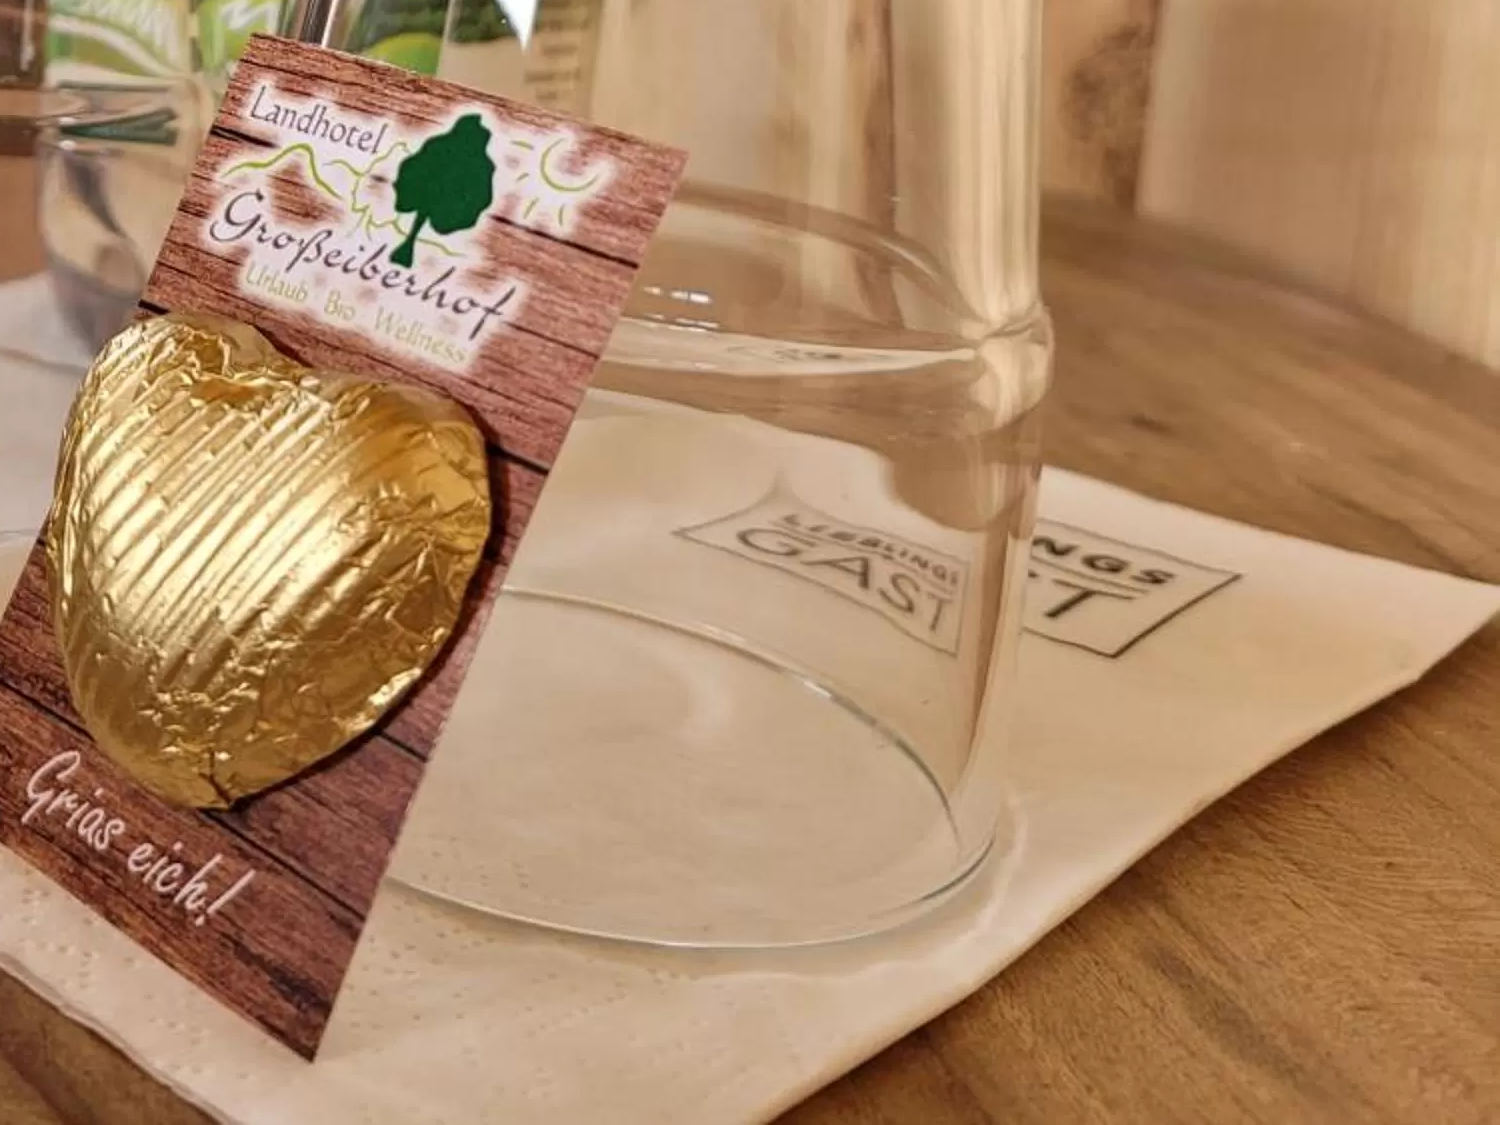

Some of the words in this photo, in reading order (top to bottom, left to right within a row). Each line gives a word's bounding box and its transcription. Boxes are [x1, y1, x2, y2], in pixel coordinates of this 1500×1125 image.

[249, 85, 389, 155] Landhotel
[209, 190, 518, 341] Großeiberhof
[245, 264, 311, 304] Urlaub
[323, 290, 357, 323] Bio
[374, 305, 467, 365] Wellness
[735, 527, 953, 633] GAST
[20, 749, 126, 852] Grias
[126, 840, 257, 928] eich!
